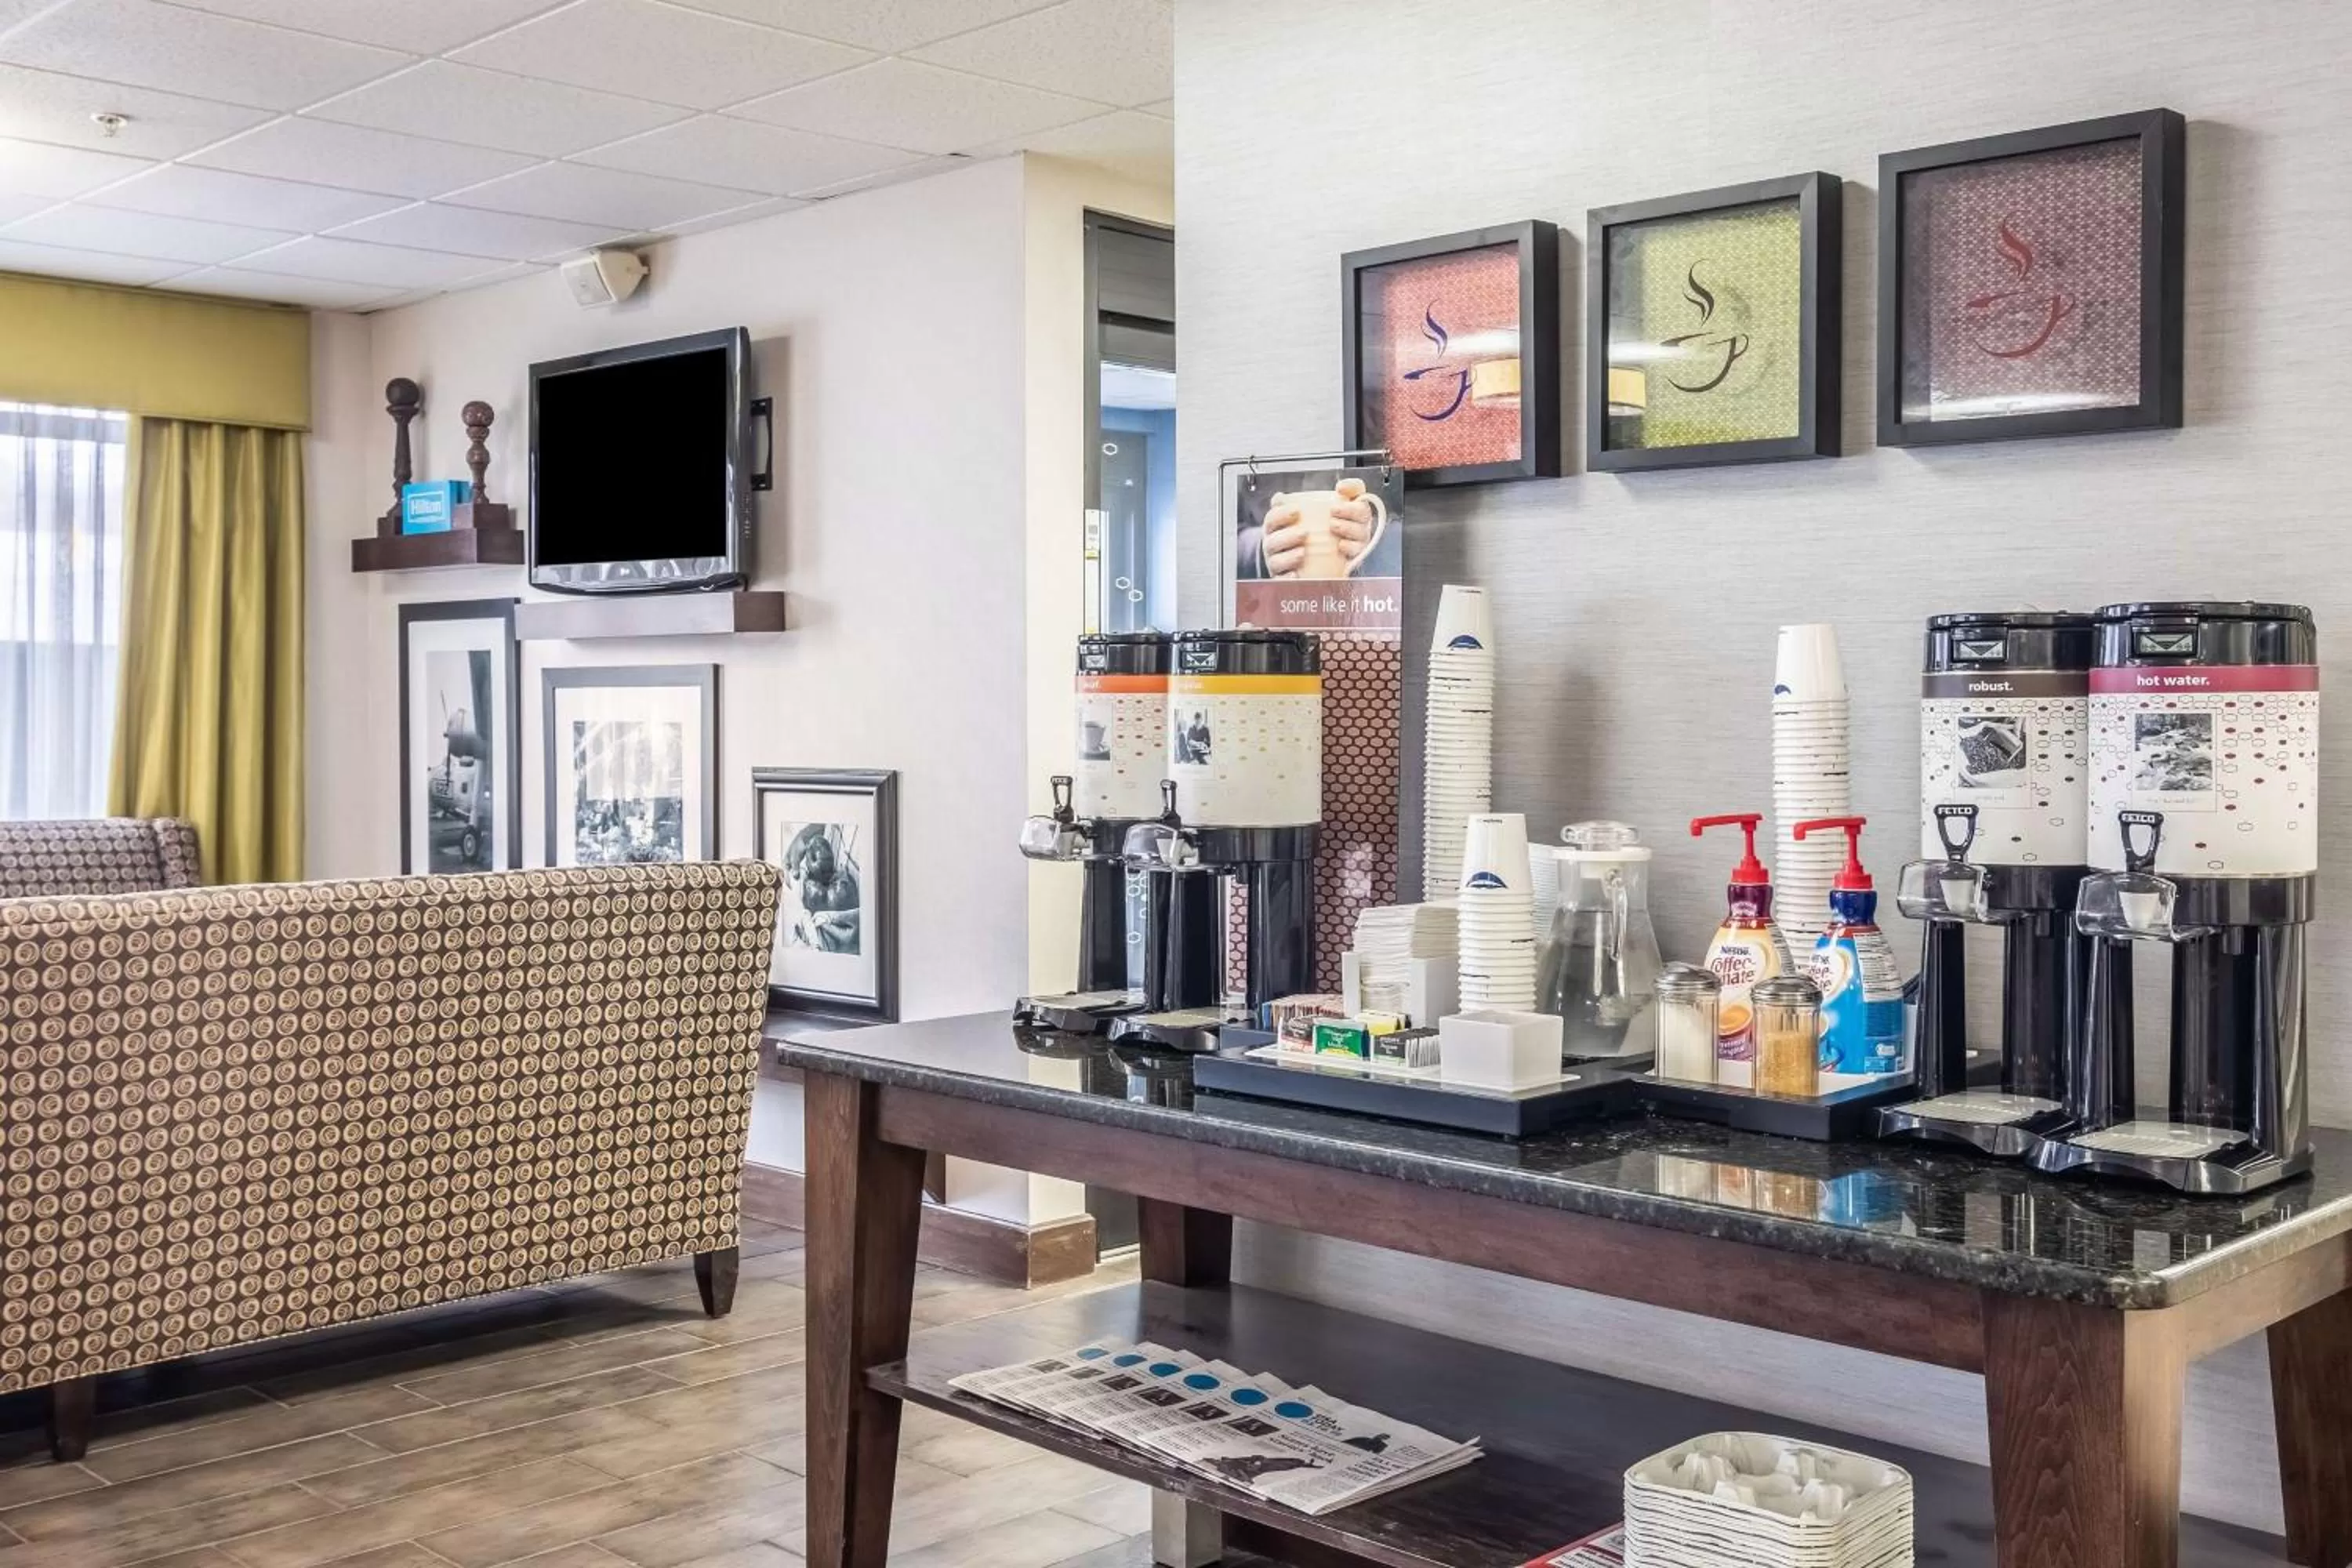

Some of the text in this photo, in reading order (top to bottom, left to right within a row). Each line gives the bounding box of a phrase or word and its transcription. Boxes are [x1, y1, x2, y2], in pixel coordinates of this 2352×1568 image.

[1280, 594, 1399, 613] some like it hot.
[1968, 681, 2014, 691] robust.
[2136, 674, 2210, 687] hot water.
